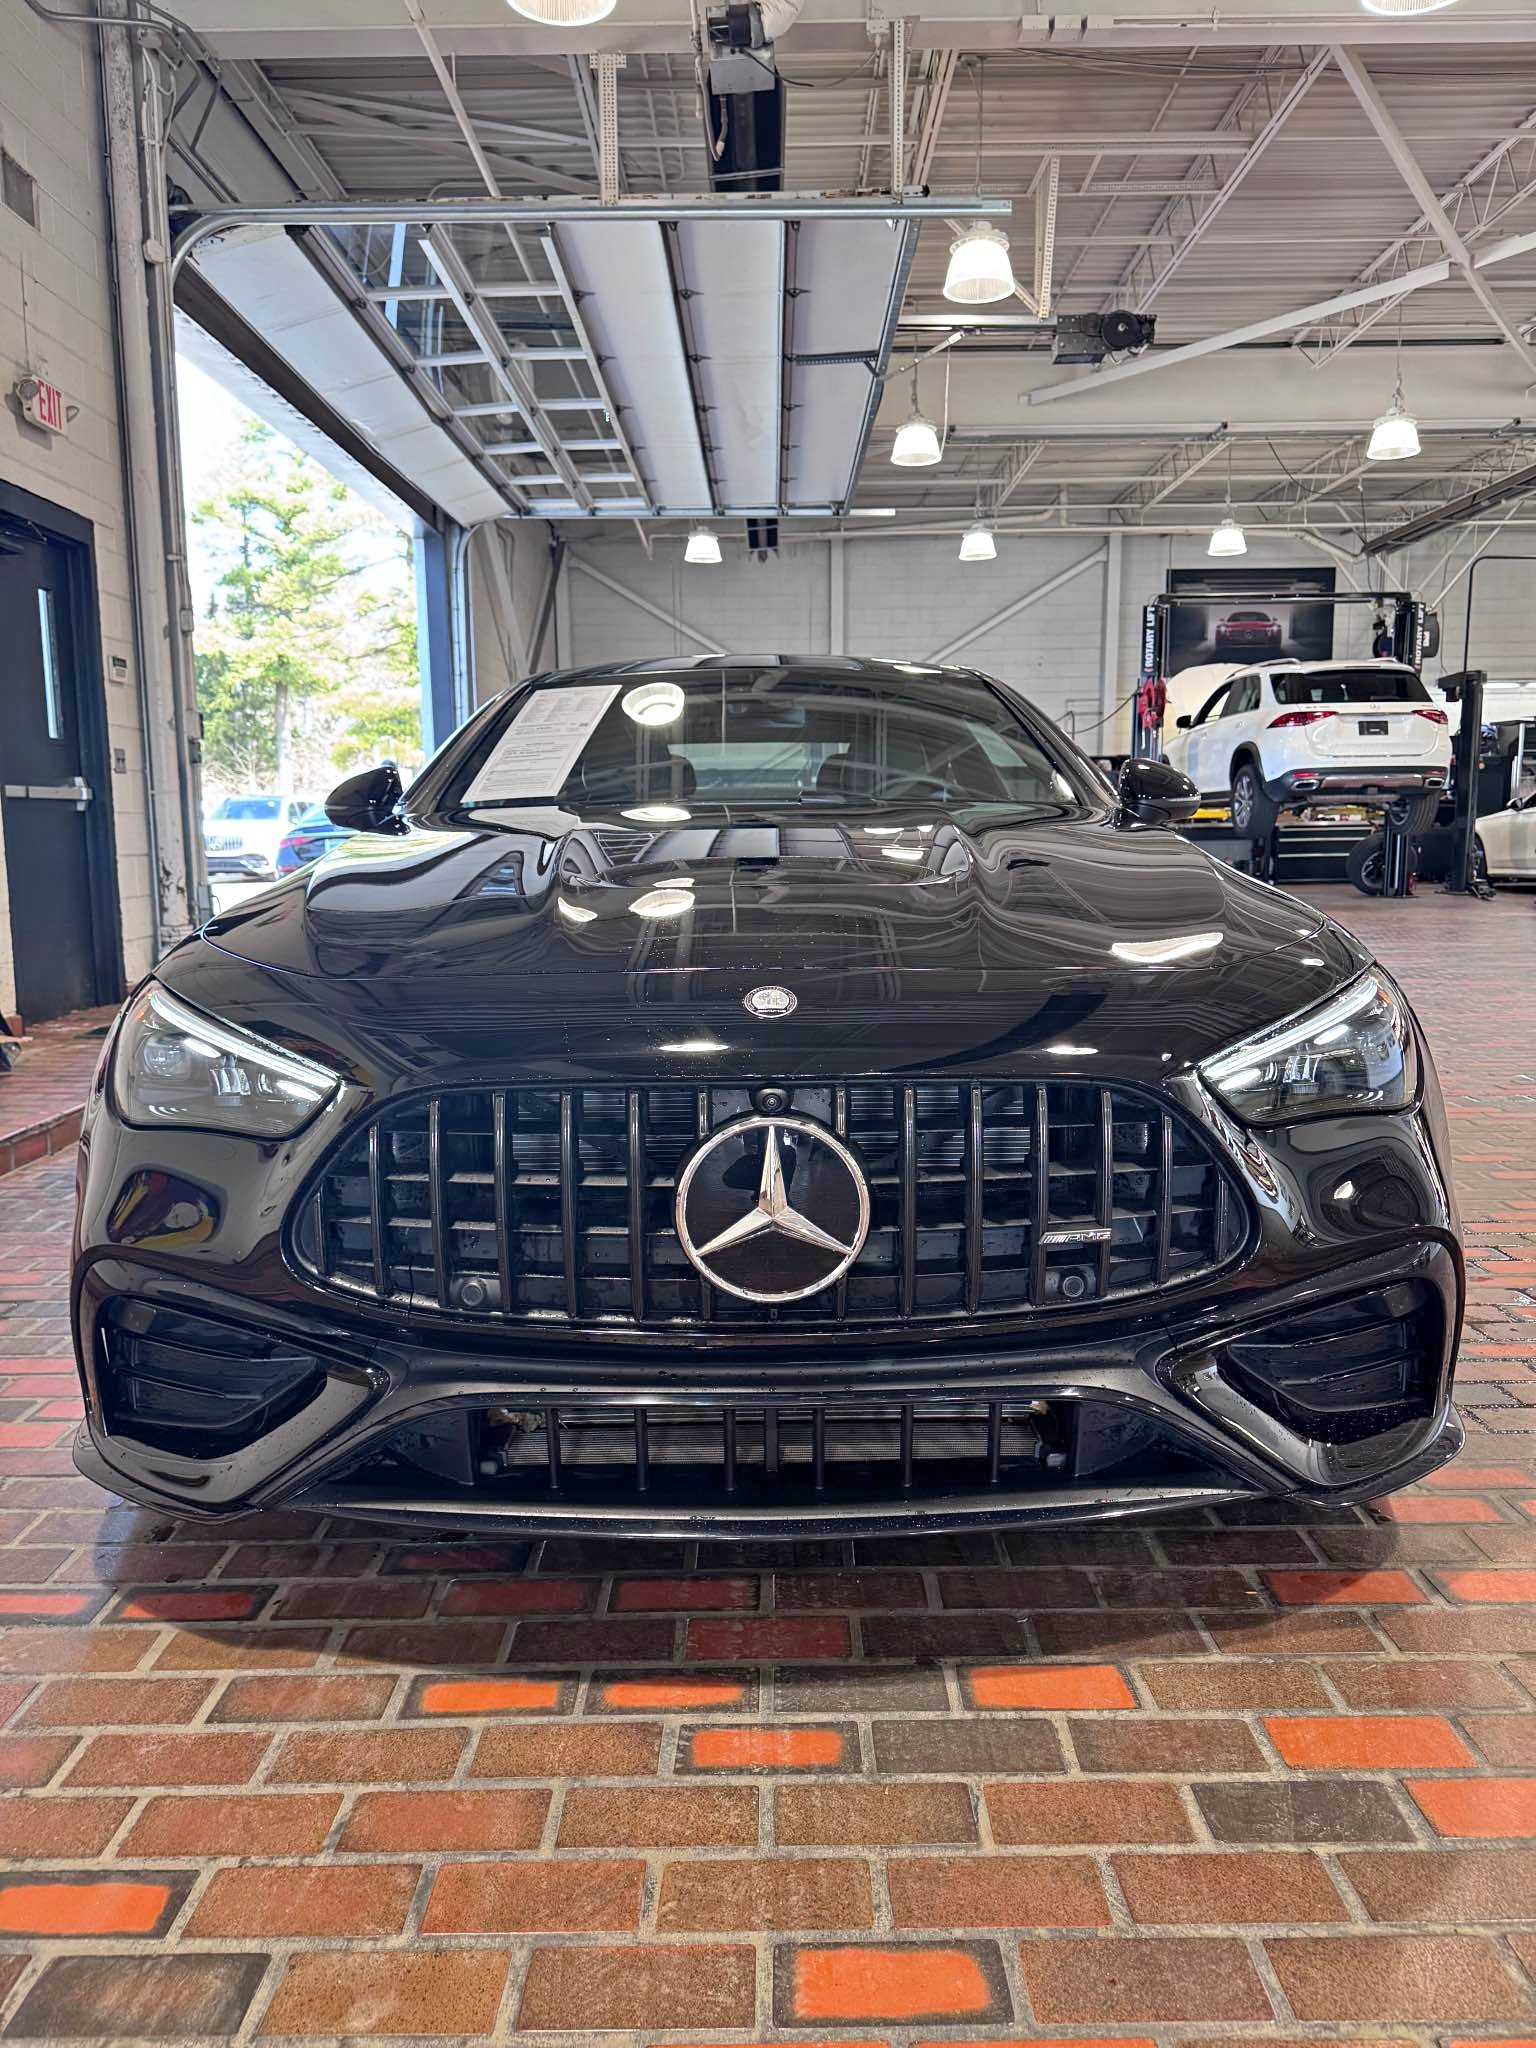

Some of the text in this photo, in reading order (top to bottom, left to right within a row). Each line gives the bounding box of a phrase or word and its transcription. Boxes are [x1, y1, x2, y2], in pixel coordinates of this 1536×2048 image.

[37, 379, 63, 430] EXIT
[1144, 606, 1155, 668] ROTARY LIFT
[1415, 603, 1425, 664] ROTARY LIFT
[1064, 1231, 1112, 1243] AMG
